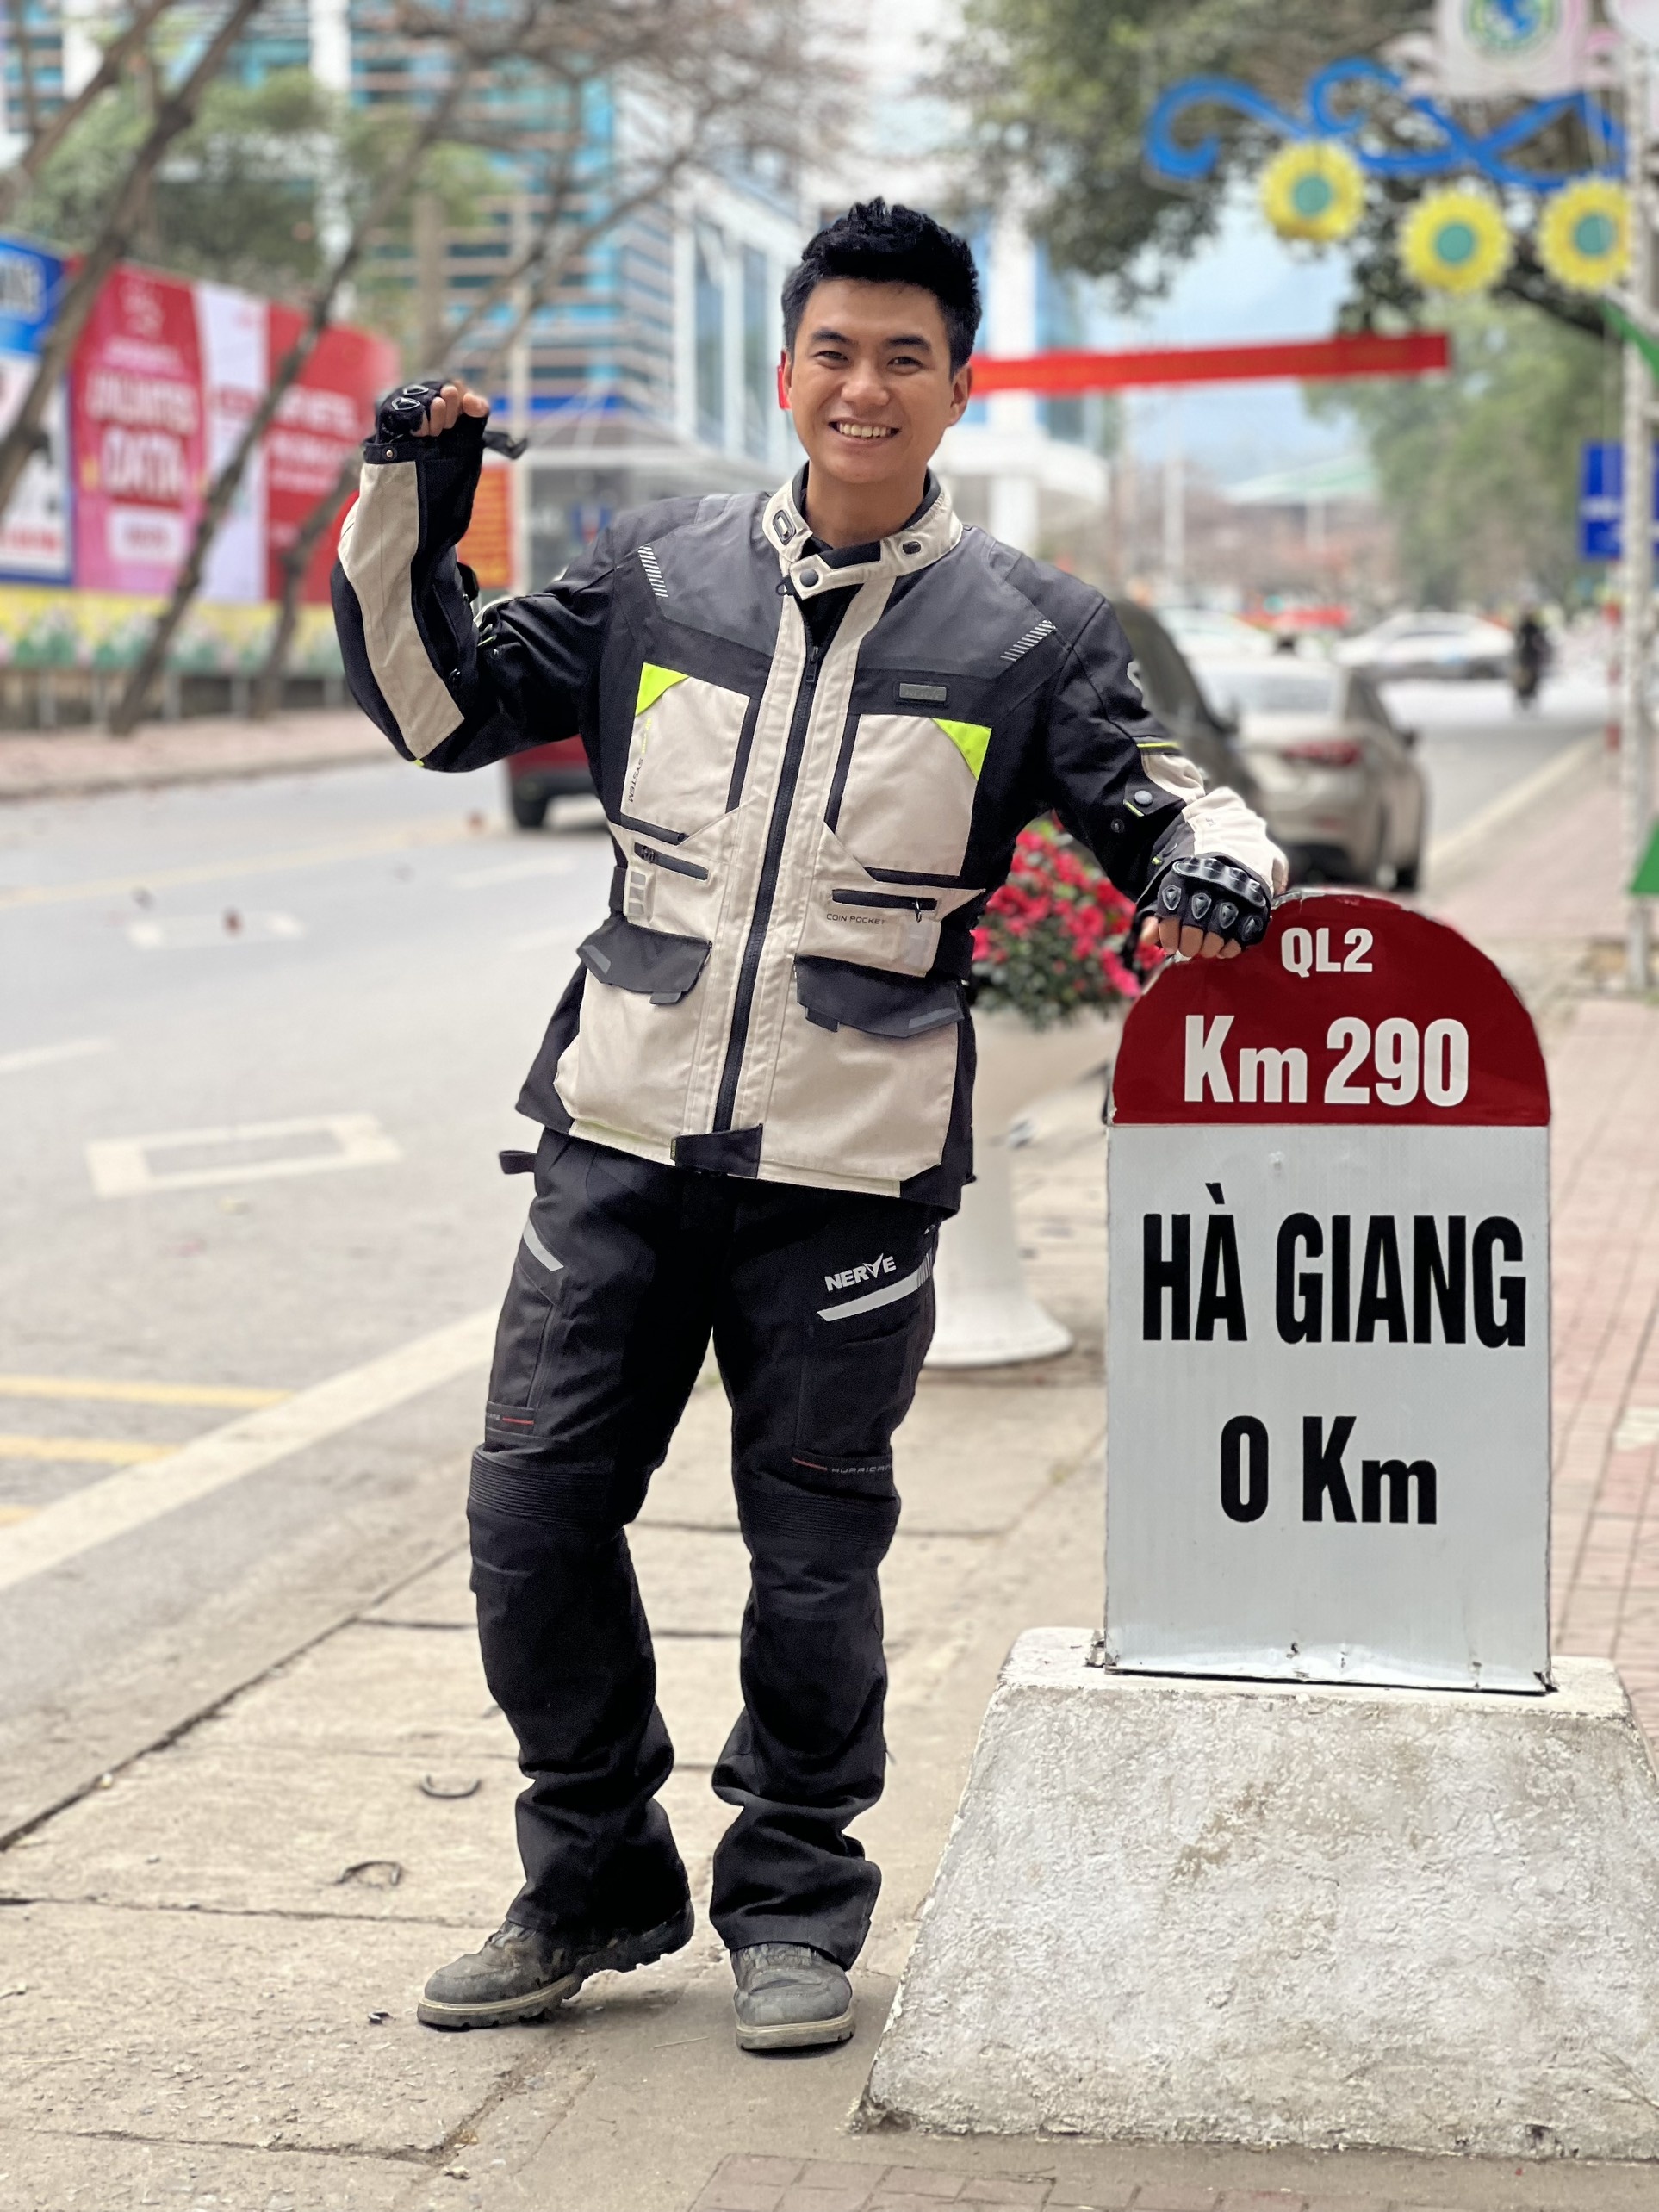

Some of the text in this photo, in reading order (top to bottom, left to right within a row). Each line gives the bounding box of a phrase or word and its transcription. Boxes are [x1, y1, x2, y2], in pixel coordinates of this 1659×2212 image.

[628, 757, 643, 803] SYSTEM
[826, 913, 886, 925] COIN POCKET
[1281, 927, 1374, 978] QL2
[1184, 1015, 1469, 1107] Km 290
[824, 1252, 897, 1292] NERVE
[1143, 1182, 1526, 1349] HÀ GIANG
[831, 1464, 892, 1474] HURRICAN
[1221, 1415, 1437, 1525] 0 Km
